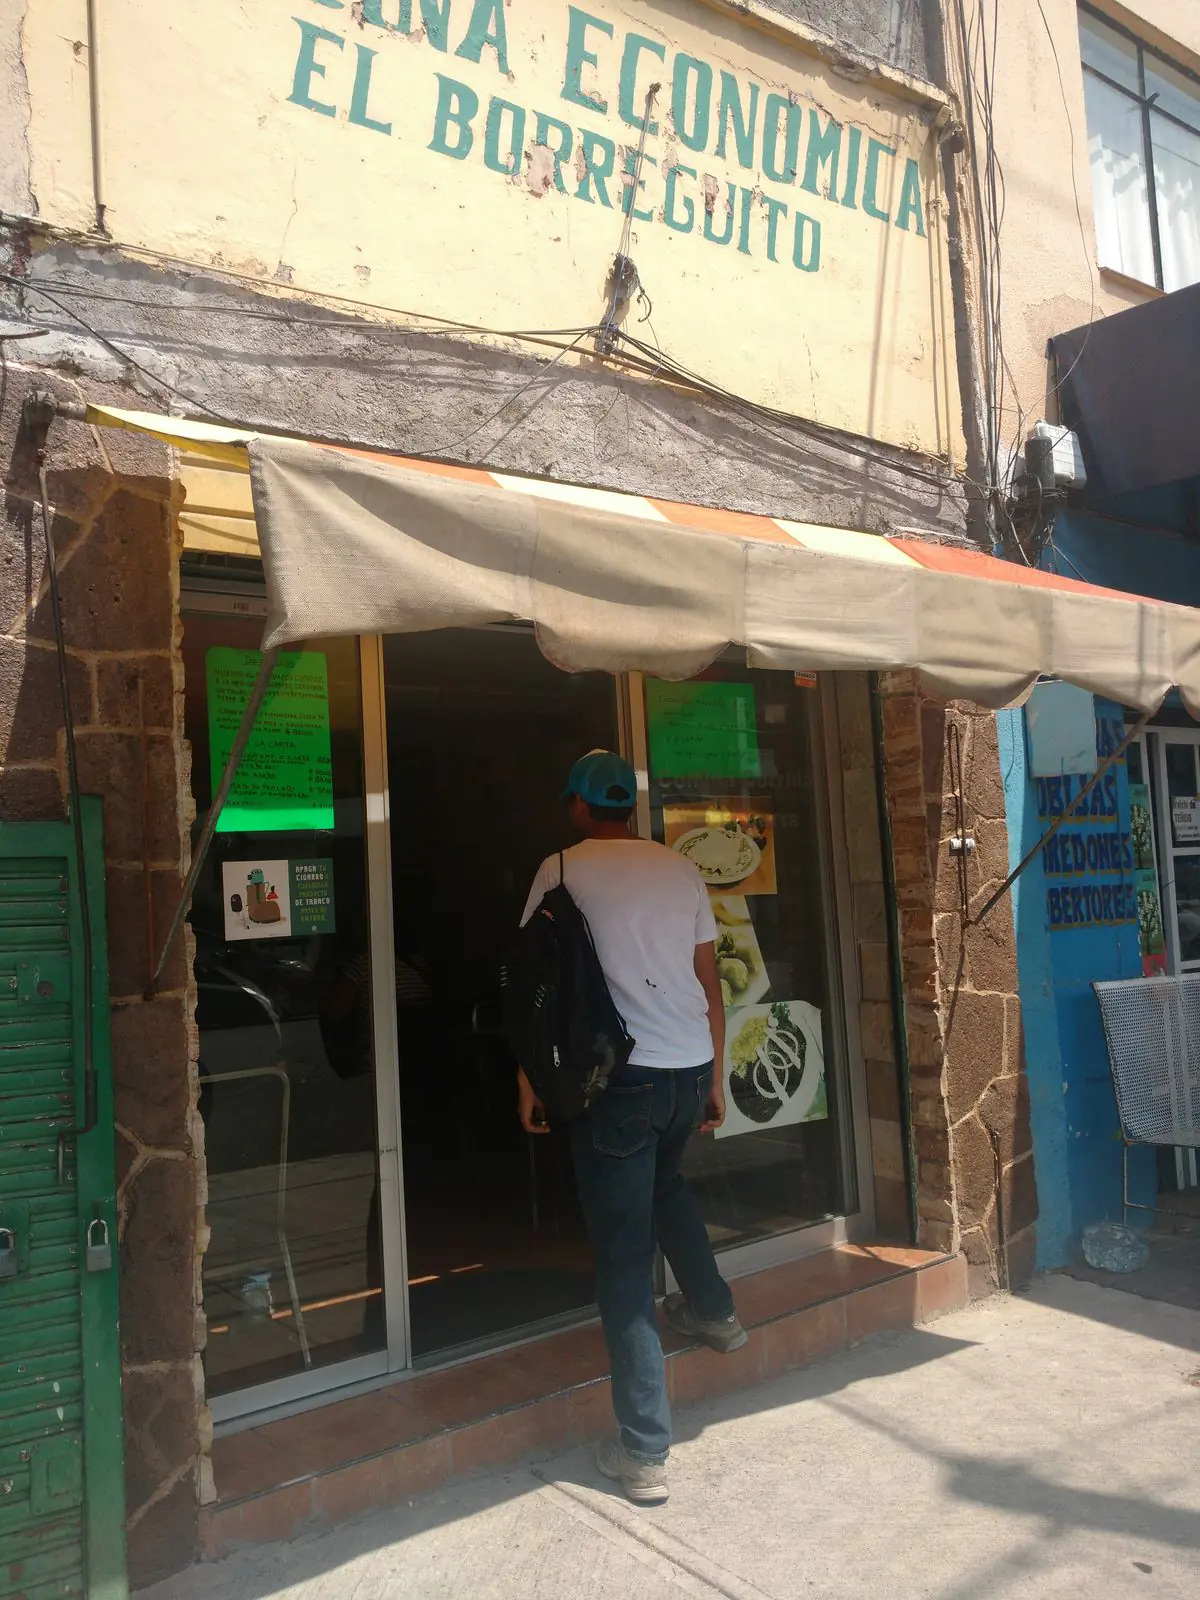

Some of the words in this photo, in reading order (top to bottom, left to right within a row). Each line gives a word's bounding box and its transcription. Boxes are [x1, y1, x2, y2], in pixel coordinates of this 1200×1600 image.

[287, 17, 392, 135] EL
[427, 72, 821, 273] BORREGUITO
[560, 5, 926, 237] ECONOMICA
